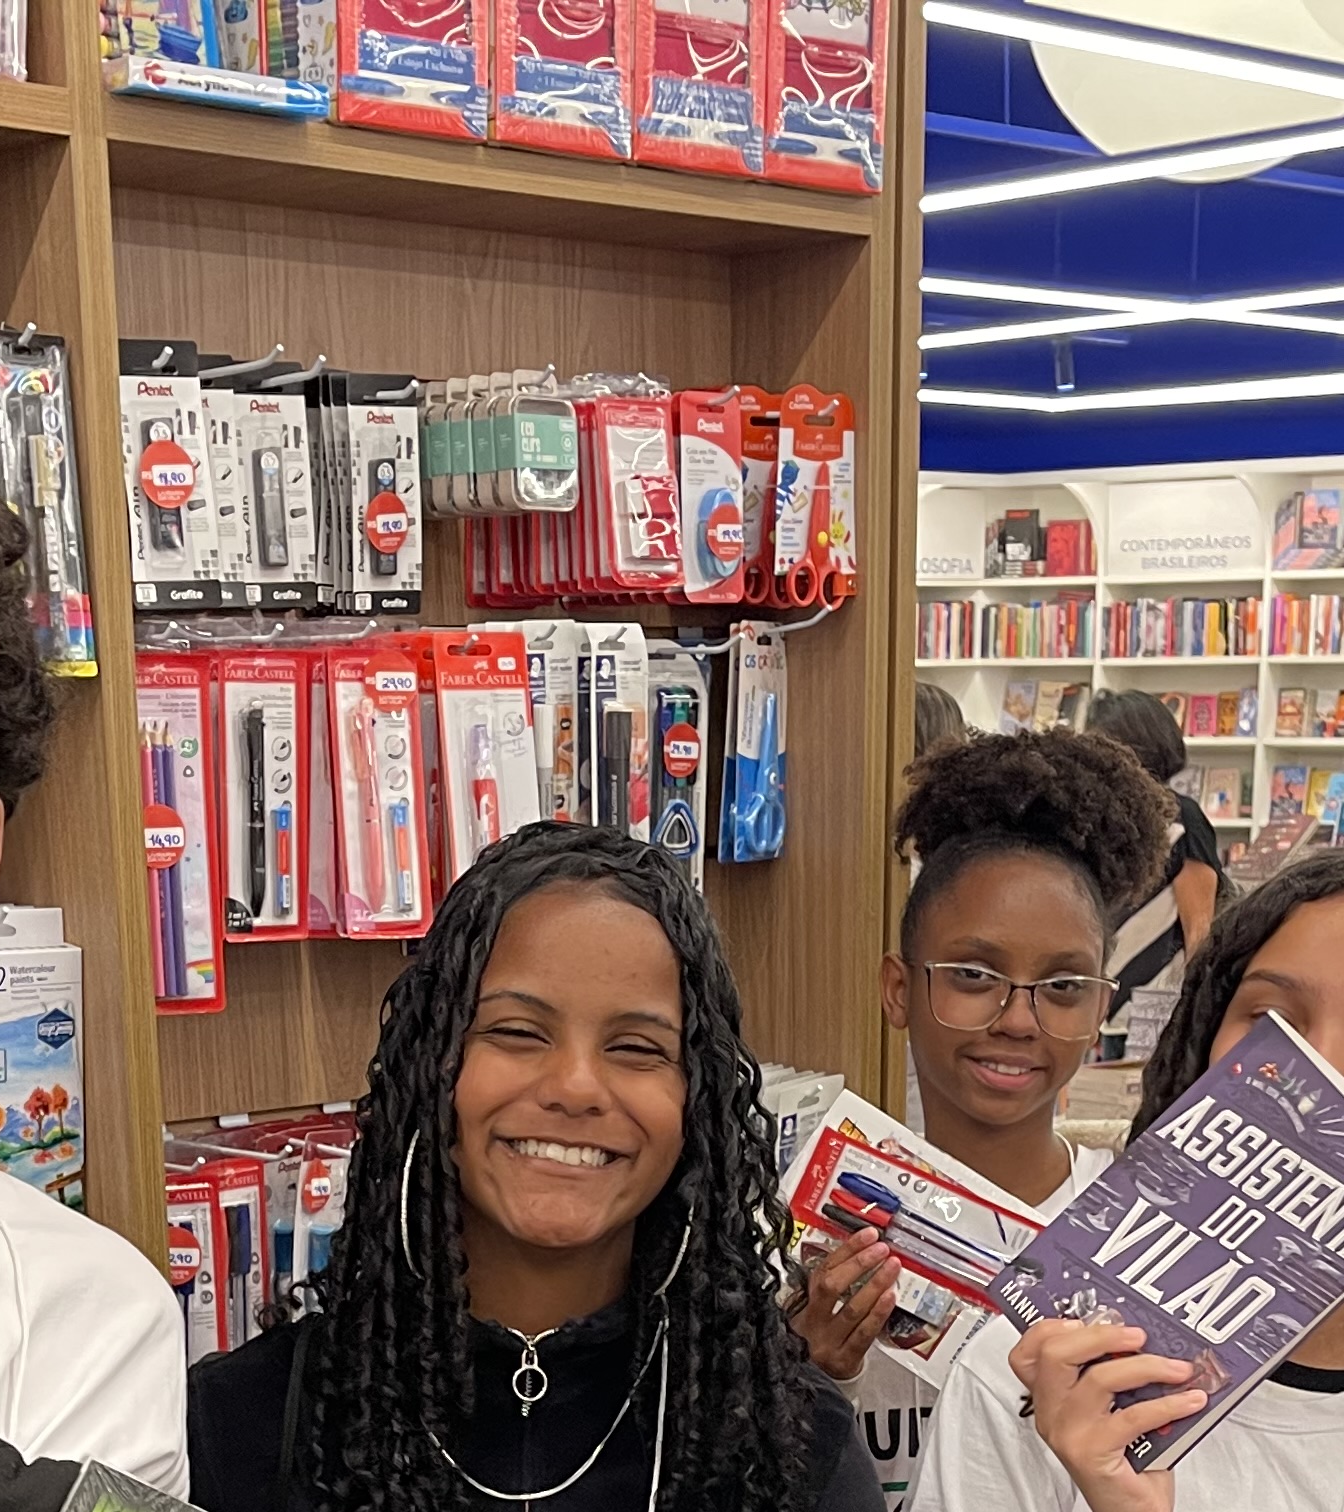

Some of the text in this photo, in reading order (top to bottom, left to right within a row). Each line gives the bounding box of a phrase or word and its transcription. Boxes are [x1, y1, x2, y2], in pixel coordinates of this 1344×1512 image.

[137, 382, 174, 396] Pentel
[250, 399, 281, 413] Pentel
[366, 411, 395, 424] Pentel
[1119, 534, 1252, 553] CONTEMPORÂNEOS
[919, 557, 974, 575] OSOFIA
[1140, 555, 1229, 570] BRASILEIROS
[170, 590, 203, 600] Grafite
[273, 590, 302, 600] Grafite
[138, 672, 198, 685] ER-CASTELL
[224, 667, 294, 679] FABER-CASTELL
[440, 671, 524, 685] FABER-CASTELL
[167, 1190, 211, 1201] CASTELL
[1198, 1195, 1268, 1251] DO
[1089, 1196, 1278, 1346] VILÃO
[999, 1280, 1045, 1328] HANNA
